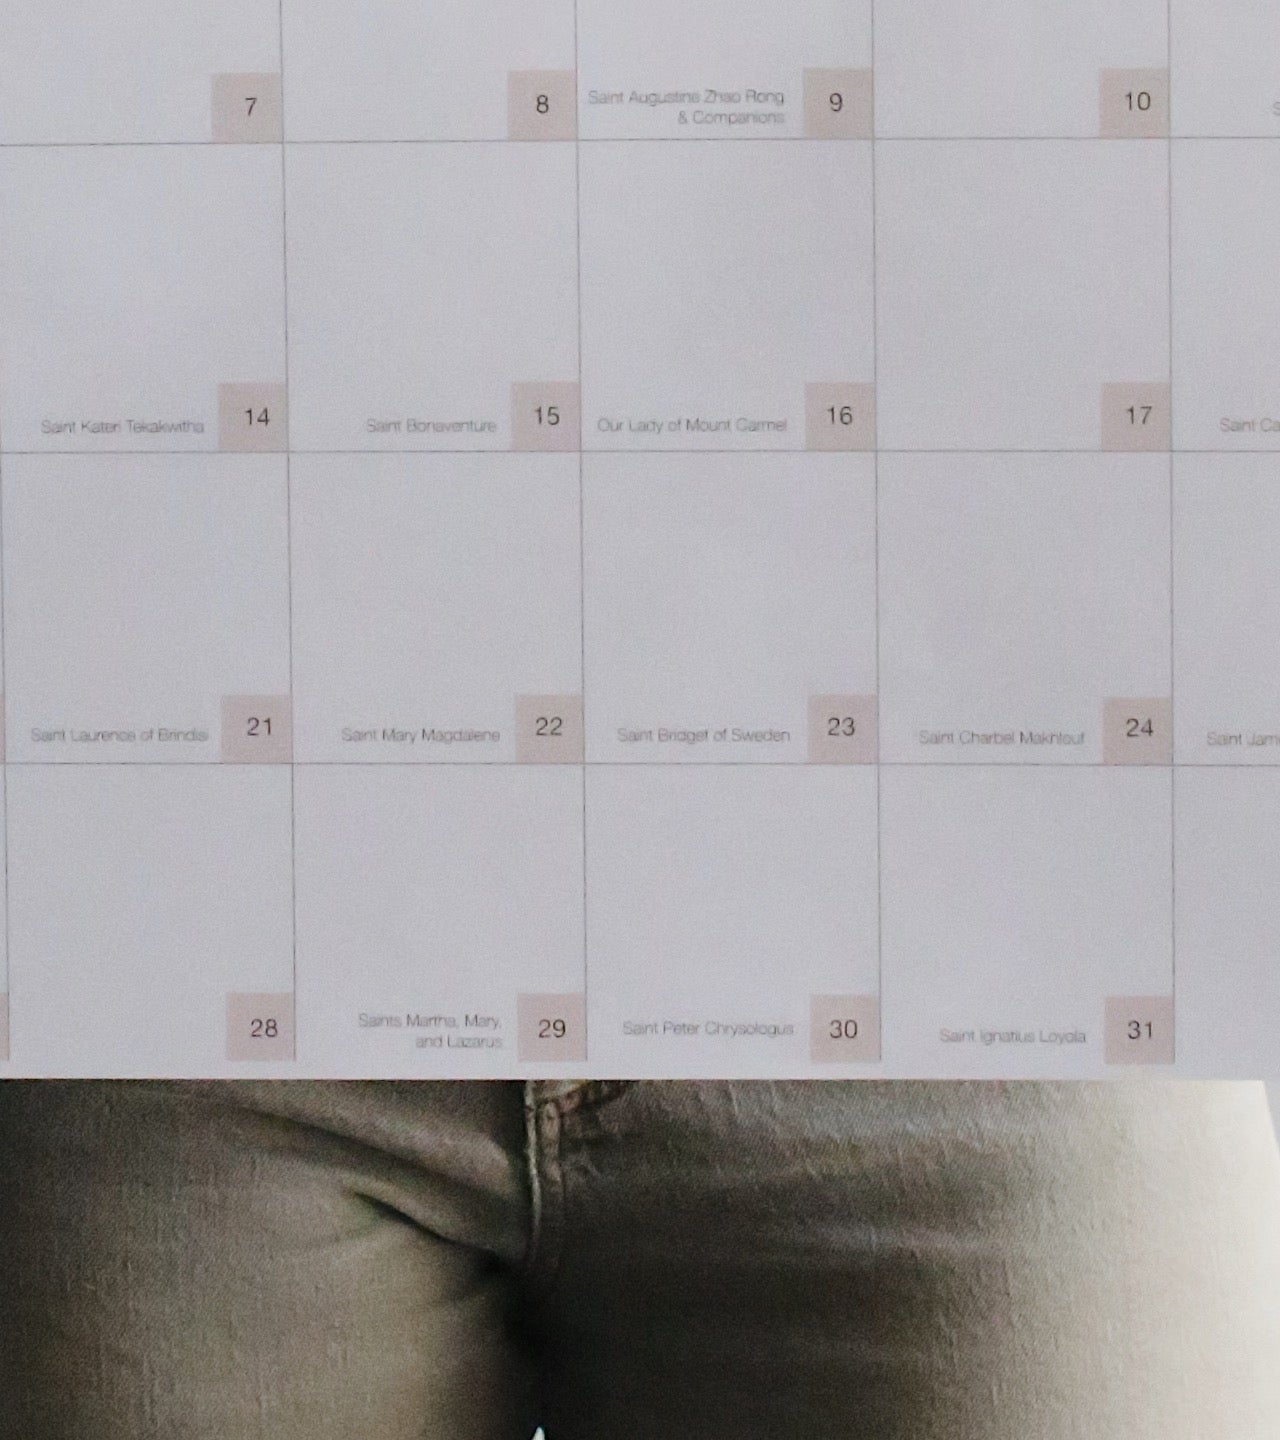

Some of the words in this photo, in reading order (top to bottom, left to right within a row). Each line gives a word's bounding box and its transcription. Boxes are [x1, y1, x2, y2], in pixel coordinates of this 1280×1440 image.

[244, 96, 258, 117] 7
[535, 94, 550, 115] 8
[590, 90, 624, 104] Saint
[628, 91, 700, 108] Augustine
[829, 92, 844, 113] 9
[1125, 91, 1152, 111] 10
[678, 110, 688, 125] &
[692, 110, 785, 126] Companions
[245, 407, 270, 426] 14
[535, 405, 560, 426] 15
[827, 405, 853, 426] 16
[1126, 405, 1153, 425] 17
[41, 421, 76, 435] Saint
[367, 418, 402, 433] Saint
[406, 418, 497, 433] Bonaventure
[597, 417, 624, 433] Our
[628, 418, 664, 435] Lady
[667, 418, 682, 432] of
[685, 417, 731, 433] Mount
[737, 417, 788, 433] Carmel
[1219, 417, 1257, 433] Saint
[31, 728, 66, 743] Saint
[141, 728, 154, 742] of
[246, 716, 272, 737] 21
[341, 729, 377, 742] Saint
[381, 727, 416, 744] Mary
[421, 727, 501, 744] Magdalene
[535, 716, 563, 737] 22
[827, 716, 856, 737] 23
[1126, 717, 1154, 738] 24
[617, 727, 653, 743] Saint
[657, 727, 709, 746] Bridget
[713, 727, 728, 742] of
[731, 728, 791, 743] Sweden
[919, 731, 954, 745] Saint
[959, 731, 1015, 745] Charbel
[1206, 731, 1243, 747] Saint
[250, 1018, 279, 1039] 28
[359, 1014, 399, 1028] Saints
[538, 1018, 567, 1039] 29
[623, 1022, 658, 1036] Saint
[662, 1020, 700, 1035] Peter
[829, 1019, 858, 1040] 30
[1127, 1019, 1153, 1041] 31
[416, 1036, 444, 1049] and
[446, 1035, 501, 1049] Lazarus
[940, 1029, 975, 1043] Saint
[979, 1029, 1035, 1047] Ignatius
[1039, 1030, 1087, 1045] Loyola
